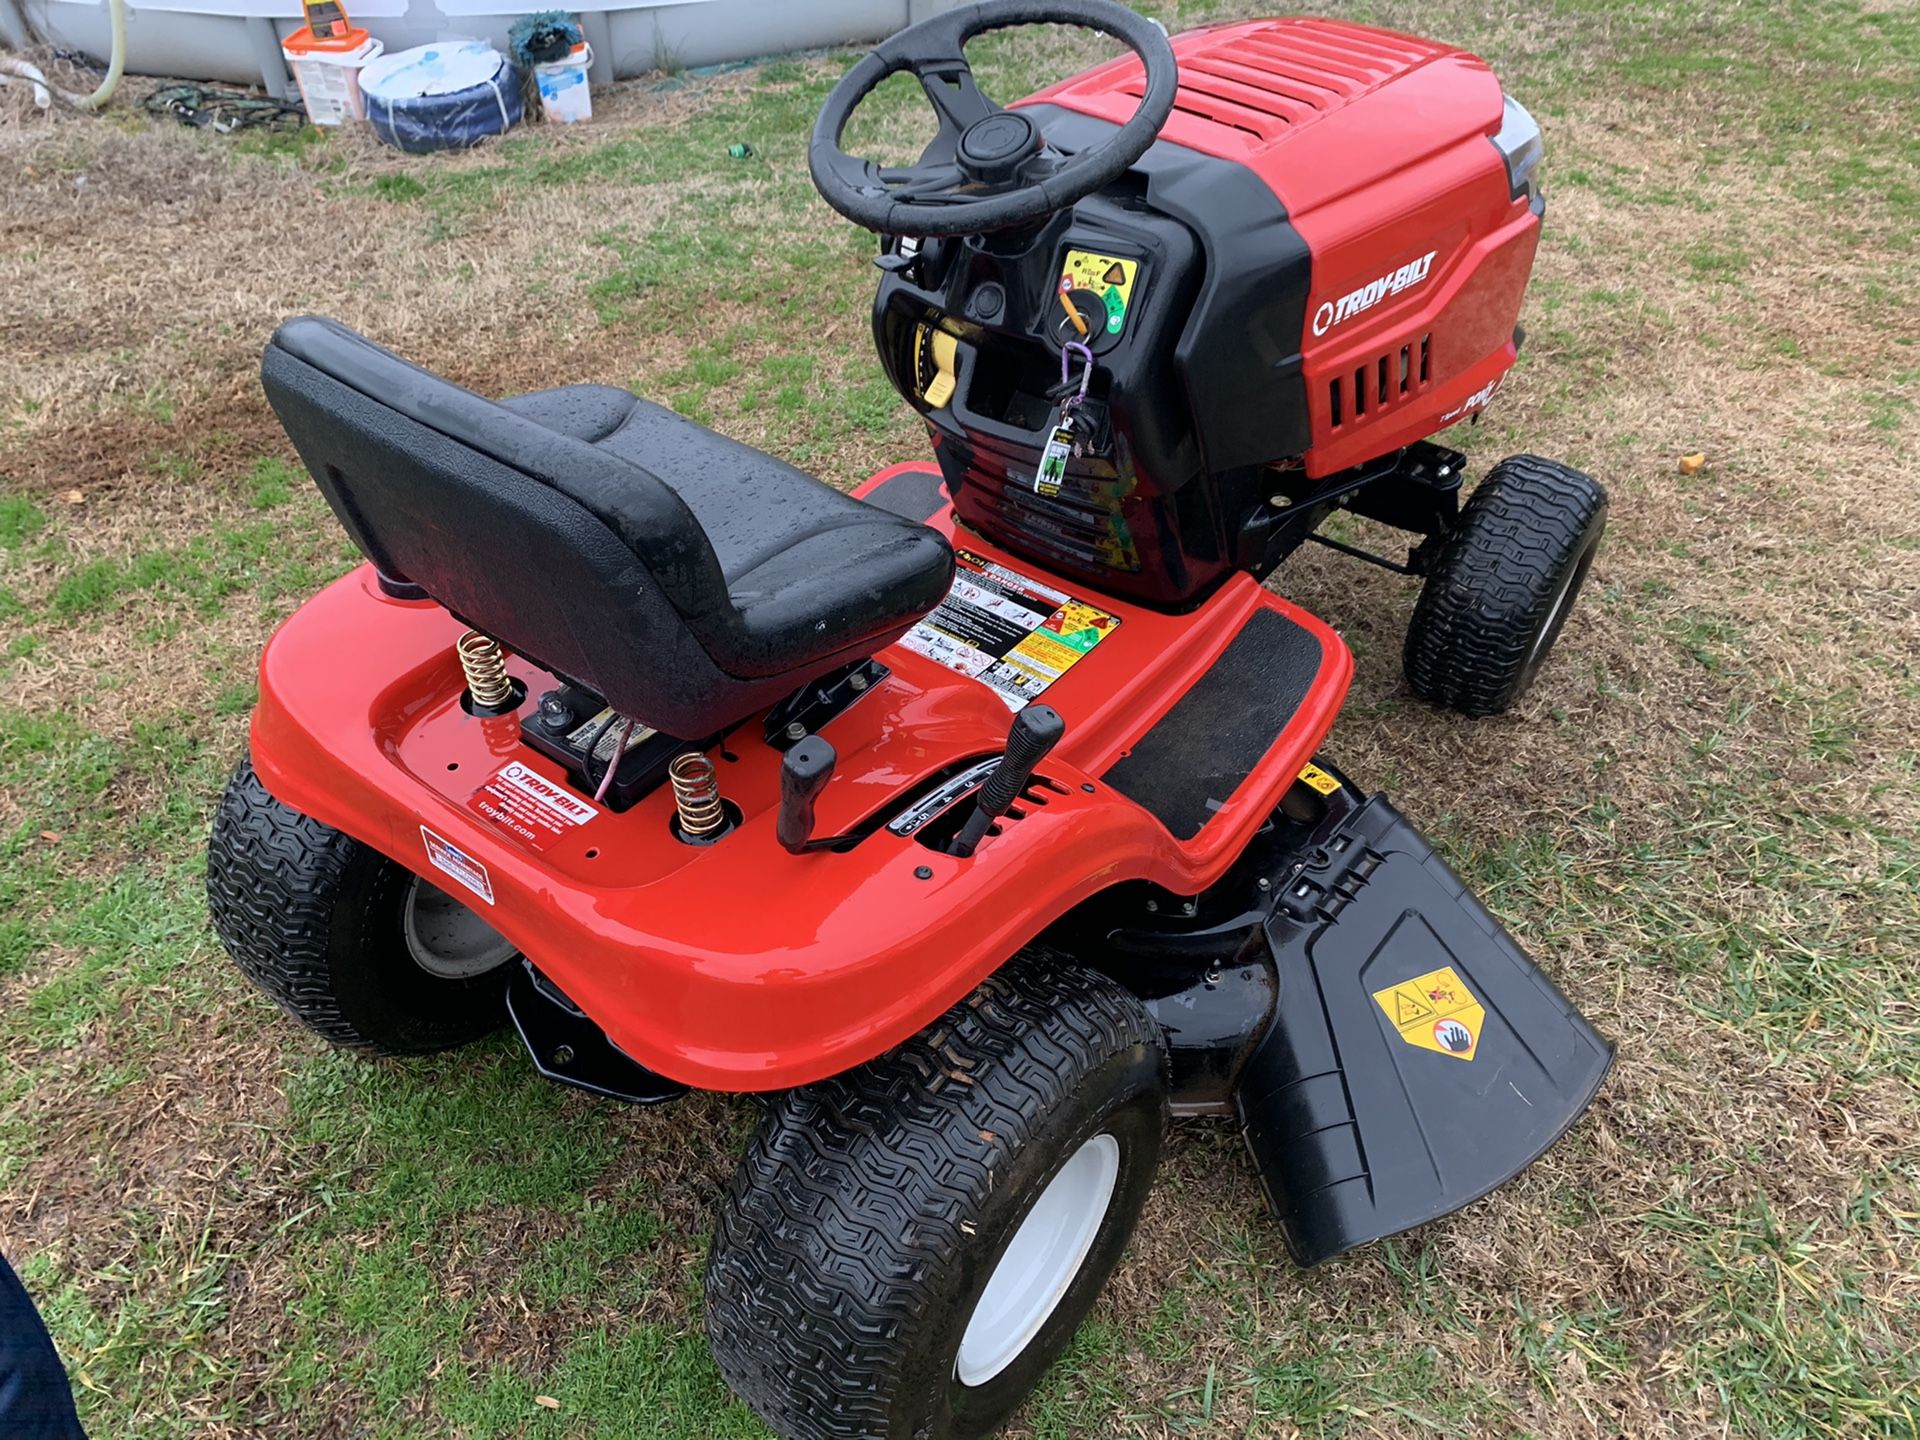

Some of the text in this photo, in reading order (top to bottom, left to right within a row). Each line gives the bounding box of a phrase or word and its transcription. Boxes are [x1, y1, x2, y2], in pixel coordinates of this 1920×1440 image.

[1333, 250, 1439, 323] TROY-BILT
[988, 573, 1025, 591] DANGER
[519, 773, 589, 816] TROY-BILT
[943, 795, 954, 804] 4
[478, 801, 536, 840] troybilt.com
[918, 811, 930, 821] 5
